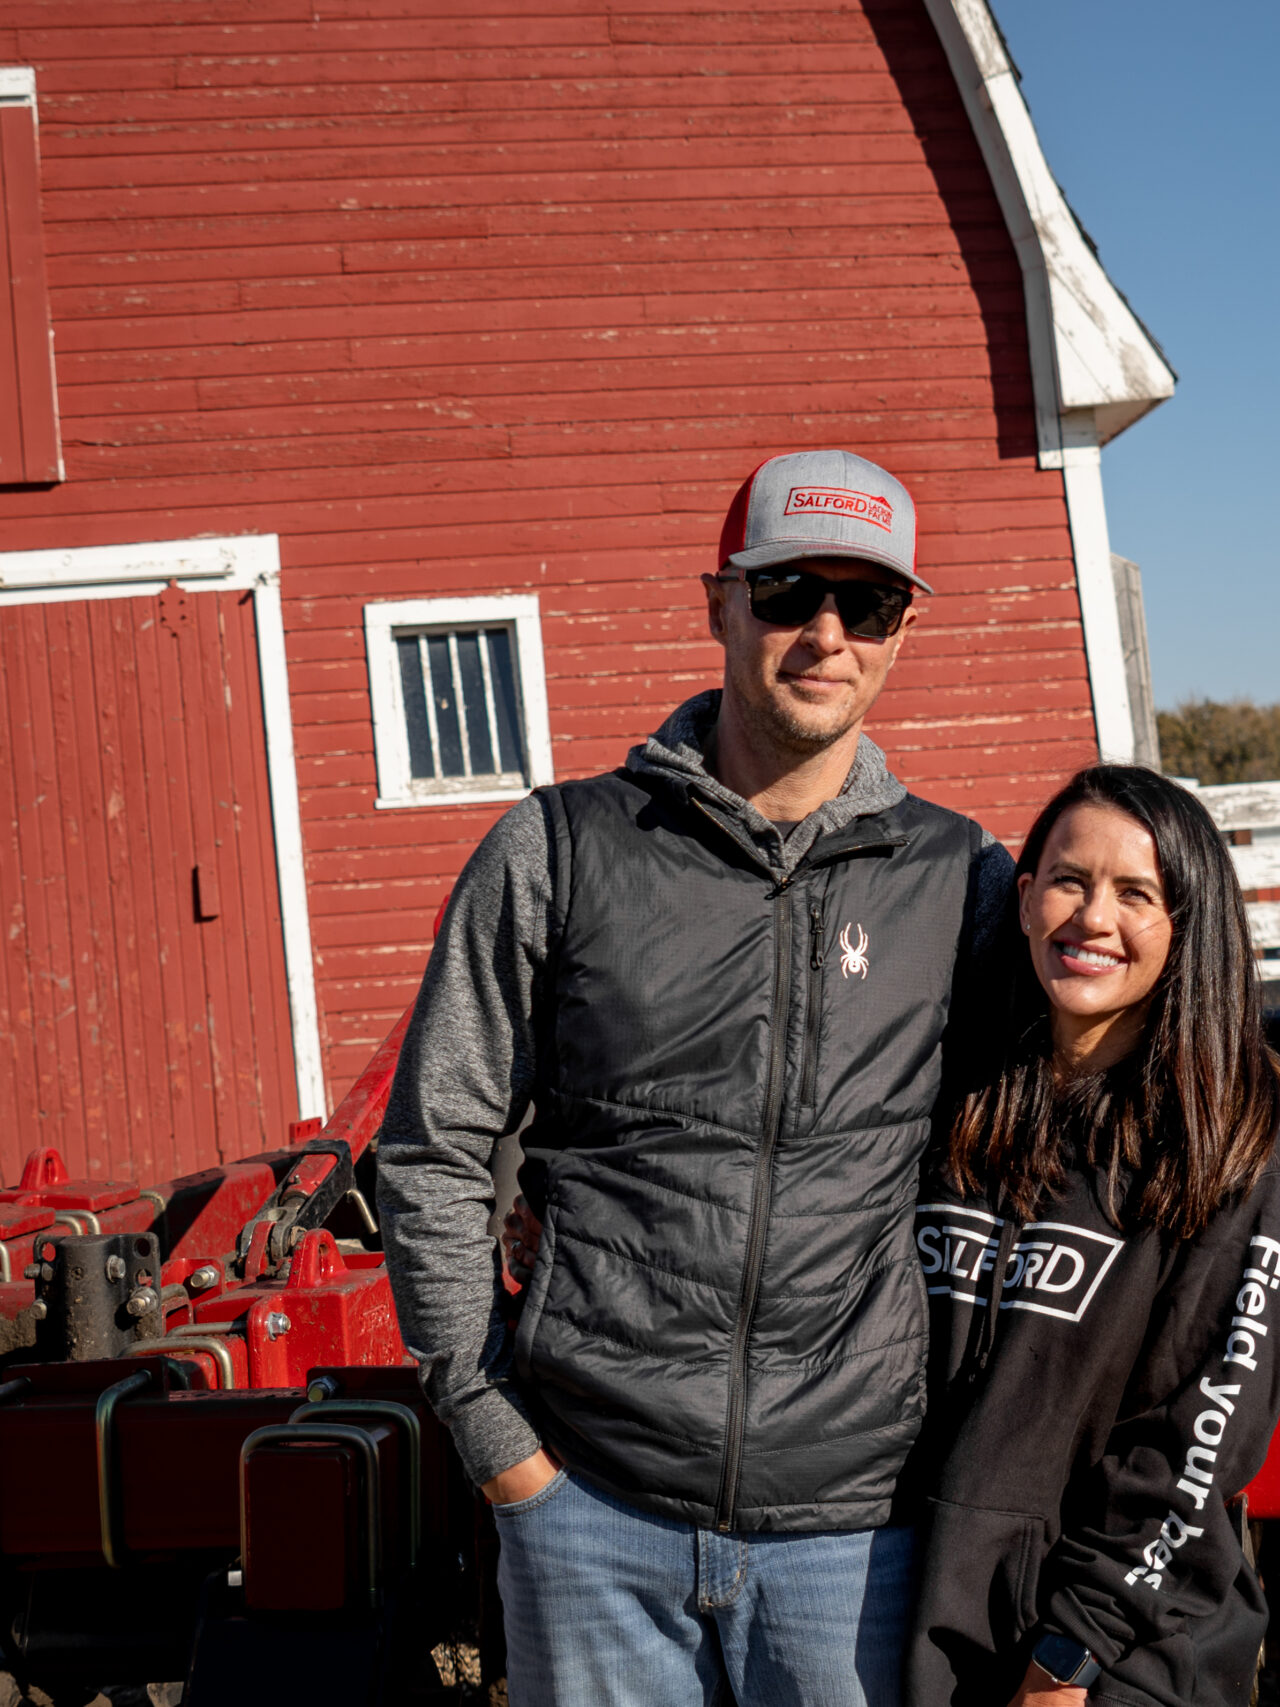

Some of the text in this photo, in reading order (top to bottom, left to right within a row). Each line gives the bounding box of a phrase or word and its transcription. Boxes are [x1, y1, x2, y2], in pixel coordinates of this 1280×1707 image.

[793, 492, 867, 514] SALFORD
[917, 1225, 1085, 1293] SLFORD
[1176, 1376, 1241, 1510] your
